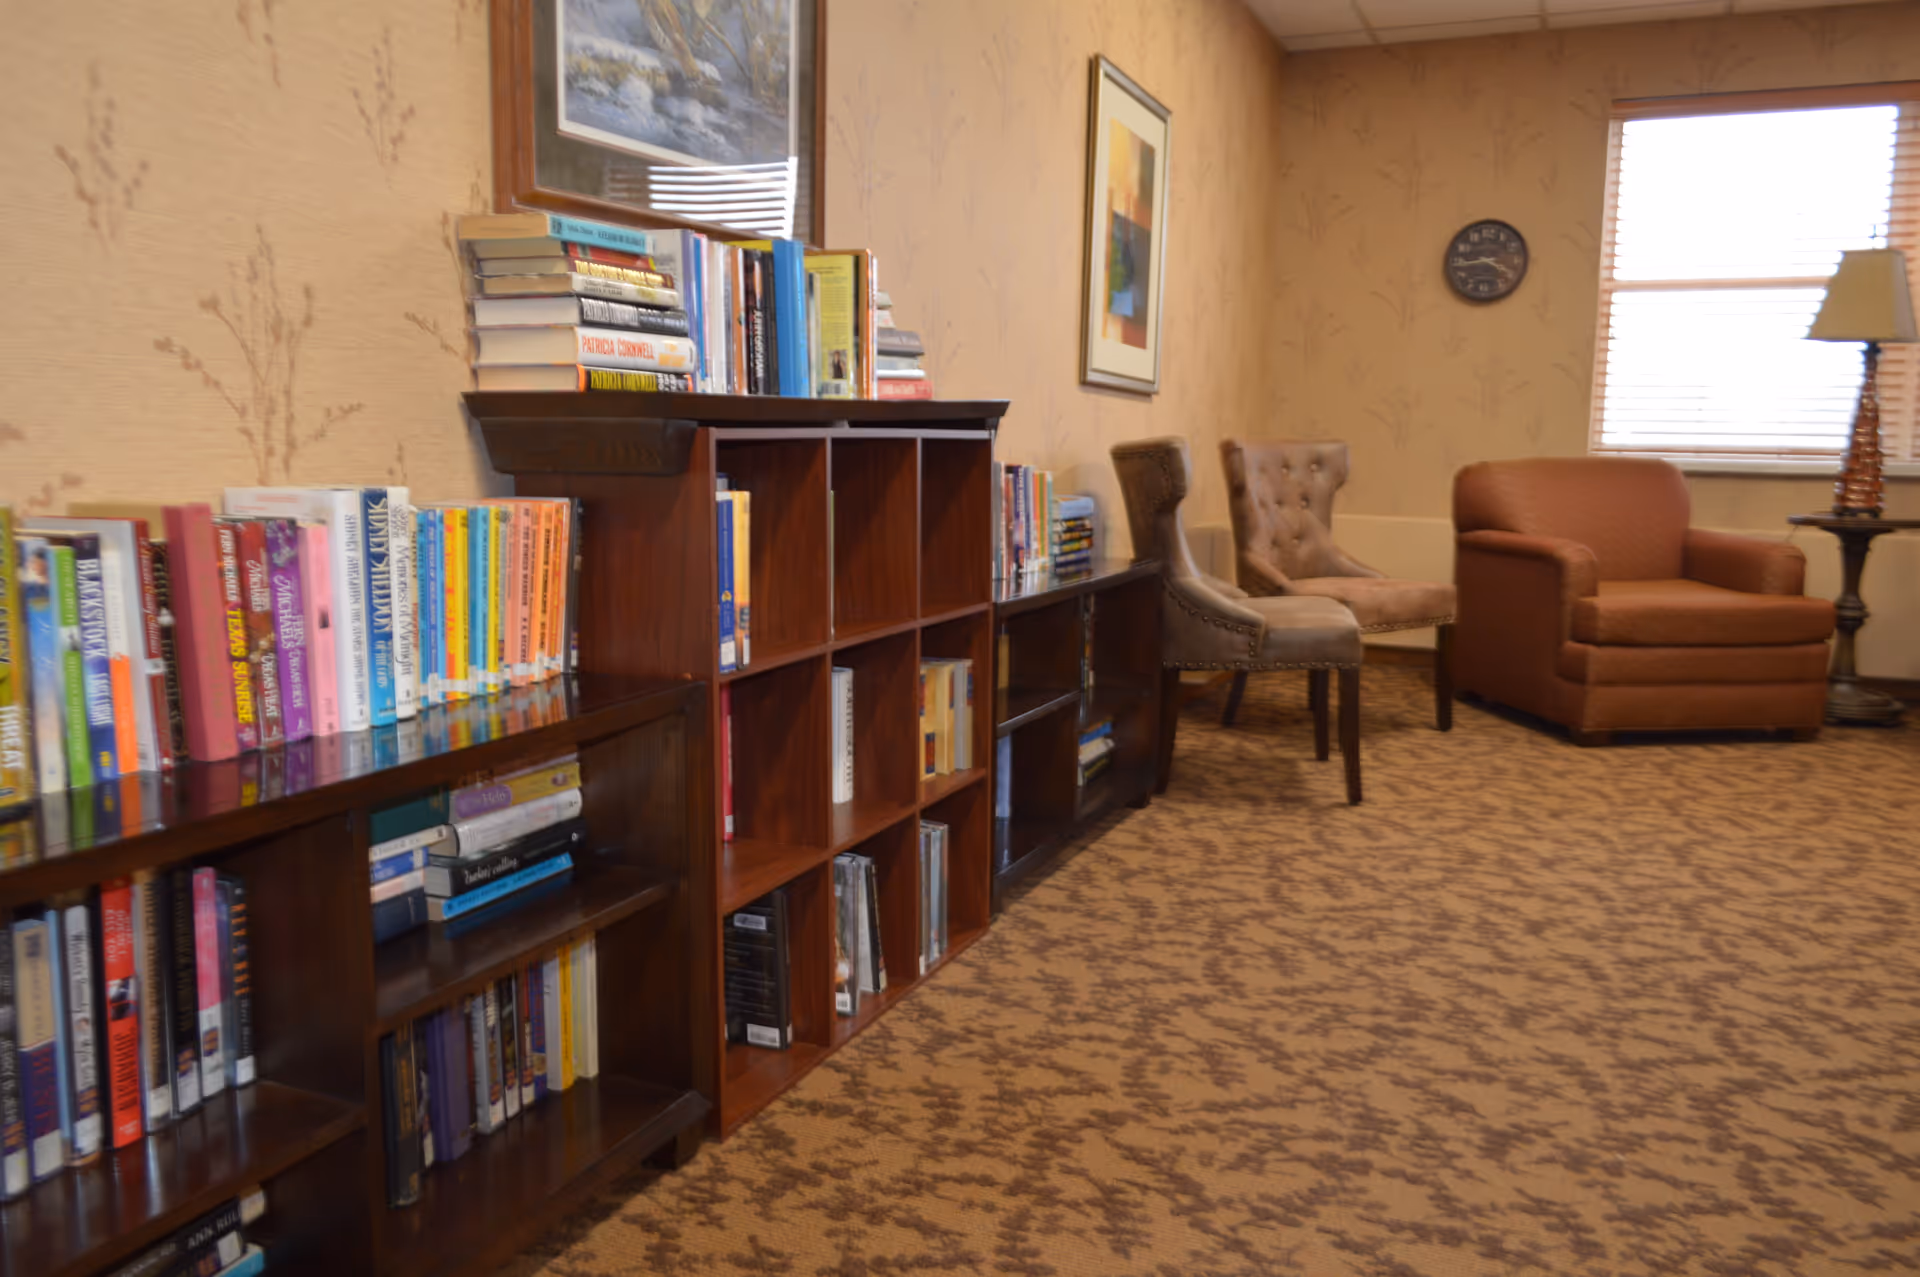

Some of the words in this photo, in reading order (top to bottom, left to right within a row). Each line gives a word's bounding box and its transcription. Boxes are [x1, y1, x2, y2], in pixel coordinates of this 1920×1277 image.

[581, 334, 615, 355] PATRICIA
[617, 337, 655, 361] CORNWELL
[366, 497, 390, 555] SIDNEY
[76, 558, 108, 659] BLACKSTOCK
[273, 574, 295, 649] MICHAELS
[370, 556, 393, 634] SHELDON
[226, 608, 249, 658] TEXAS
[232, 660, 257, 724] SUNRISE
[113, 1033, 138, 1112] JOHANSEN
